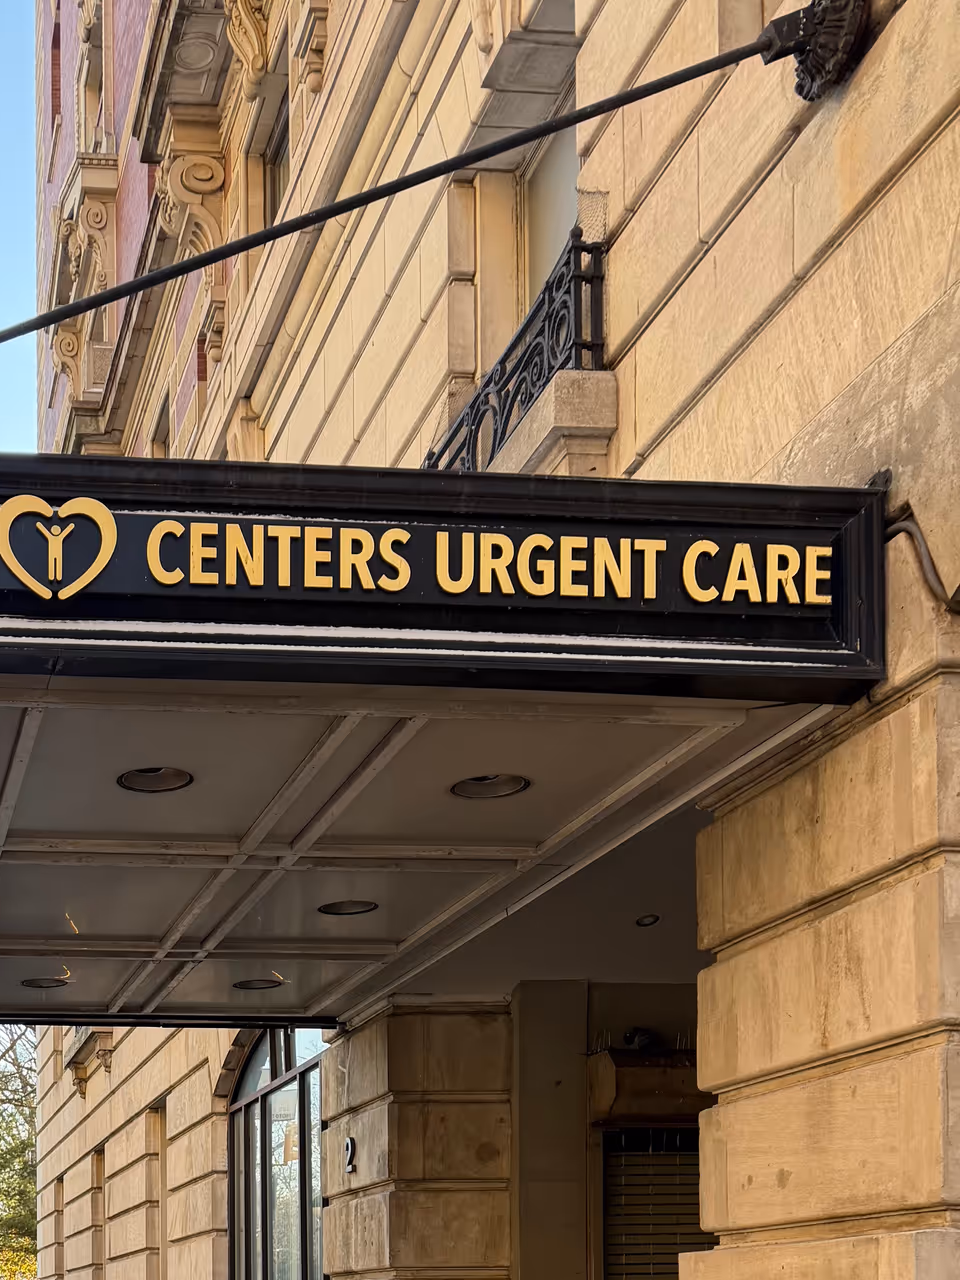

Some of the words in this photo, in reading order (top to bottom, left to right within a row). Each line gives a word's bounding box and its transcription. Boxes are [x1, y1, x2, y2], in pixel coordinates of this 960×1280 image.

[146, 520, 412, 591] CENTERS
[435, 531, 667, 600] URGENT
[682, 540, 833, 606] CARE
